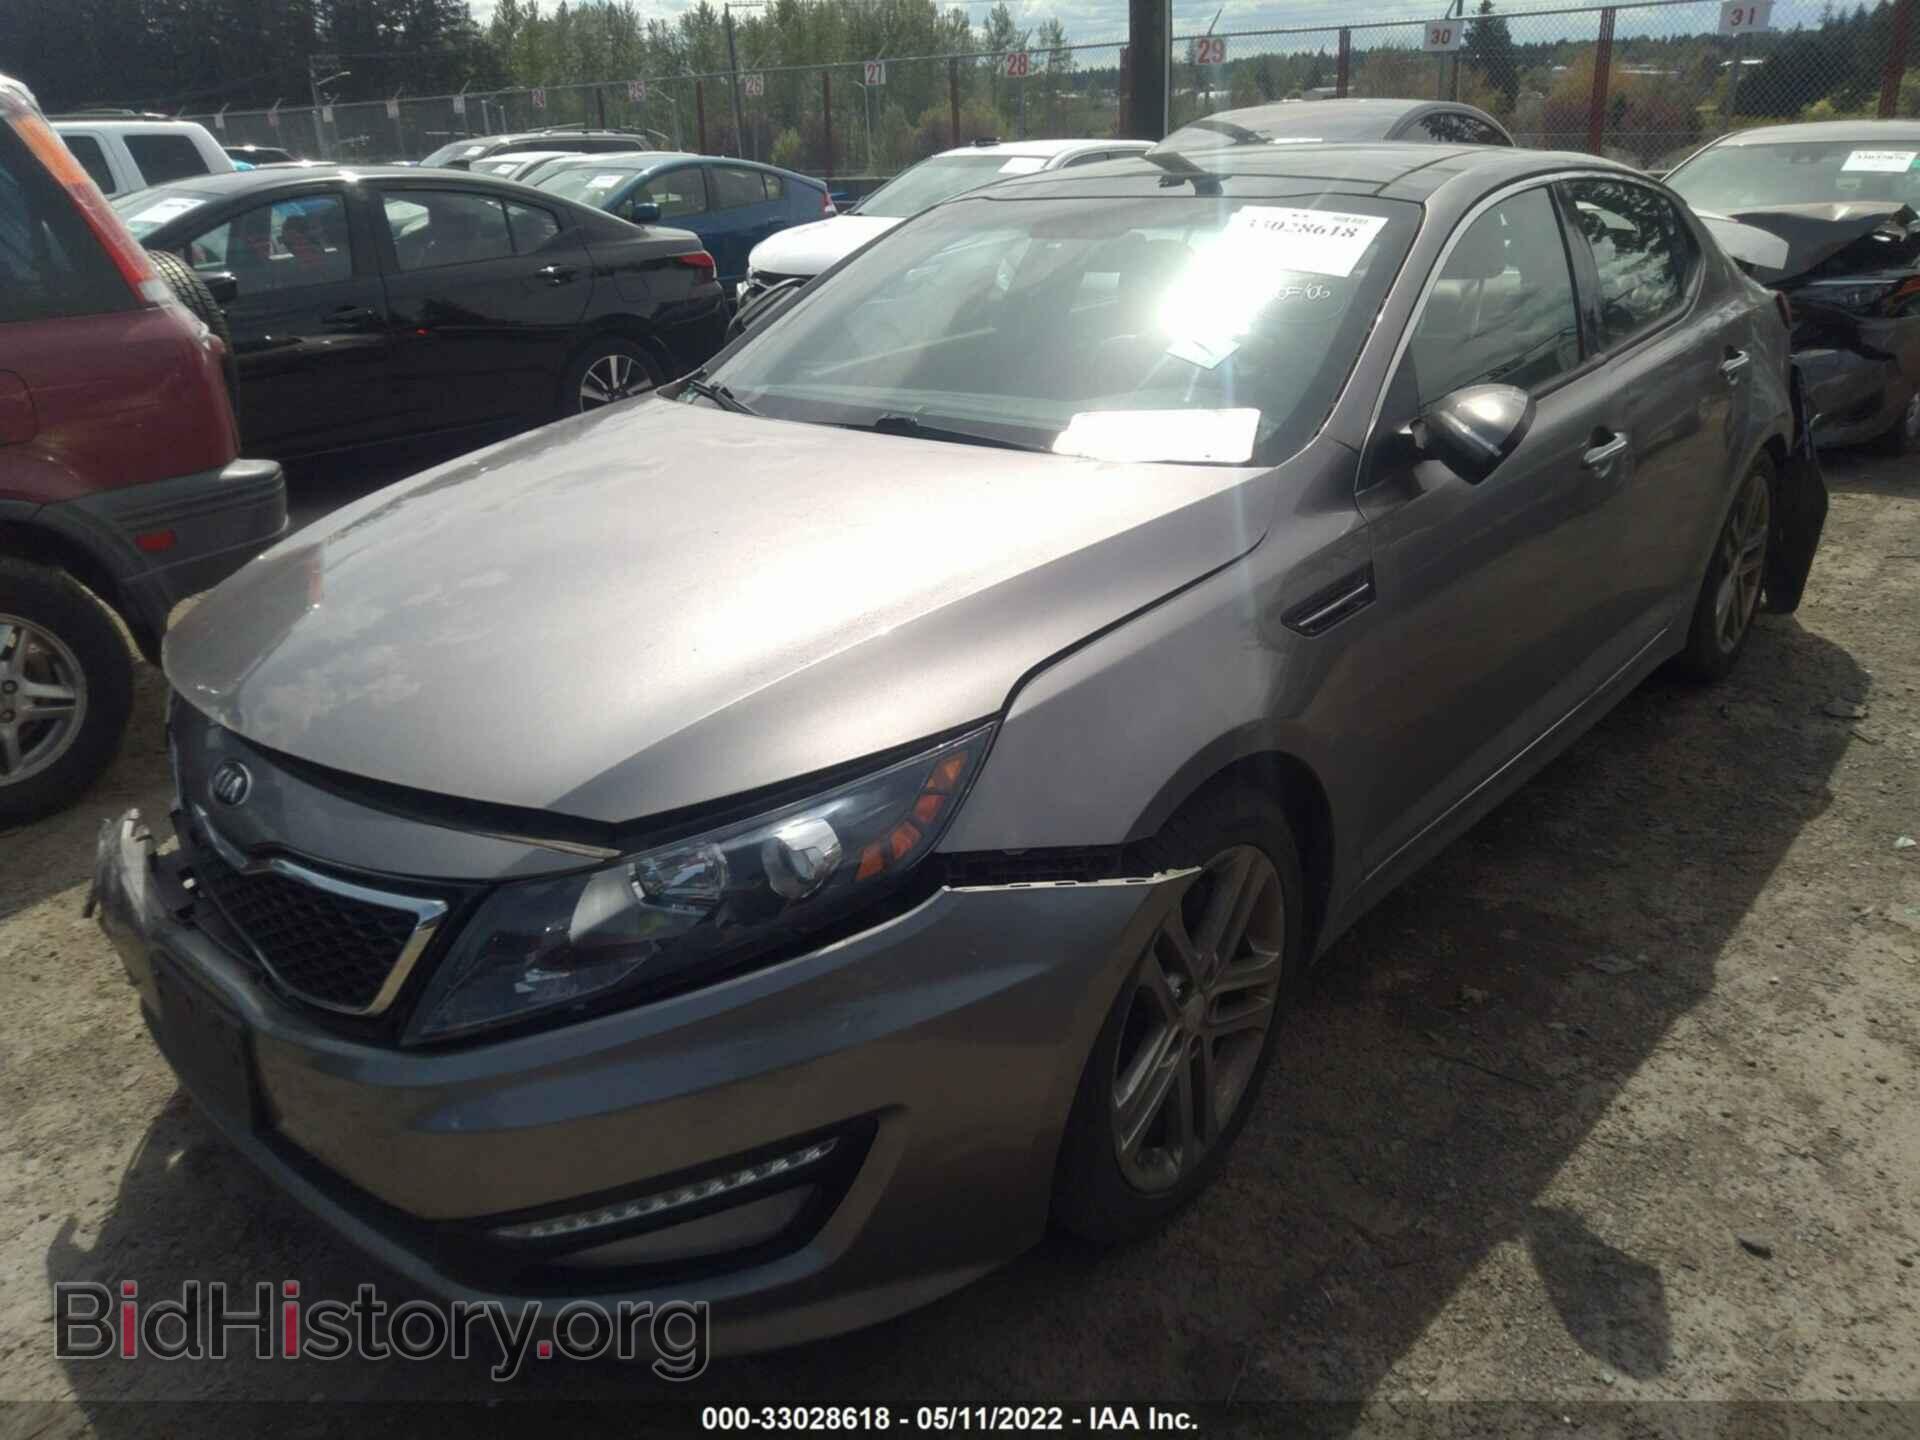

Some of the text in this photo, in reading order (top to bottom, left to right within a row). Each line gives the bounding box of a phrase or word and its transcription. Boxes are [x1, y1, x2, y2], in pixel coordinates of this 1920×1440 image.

[1730, 7, 1755, 27] 31
[1430, 28, 1450, 45] 30
[1199, 38, 1224, 64] 29
[866, 63, 884, 84] 27
[1007, 53, 1028, 77] 28
[744, 78, 762, 97] 26
